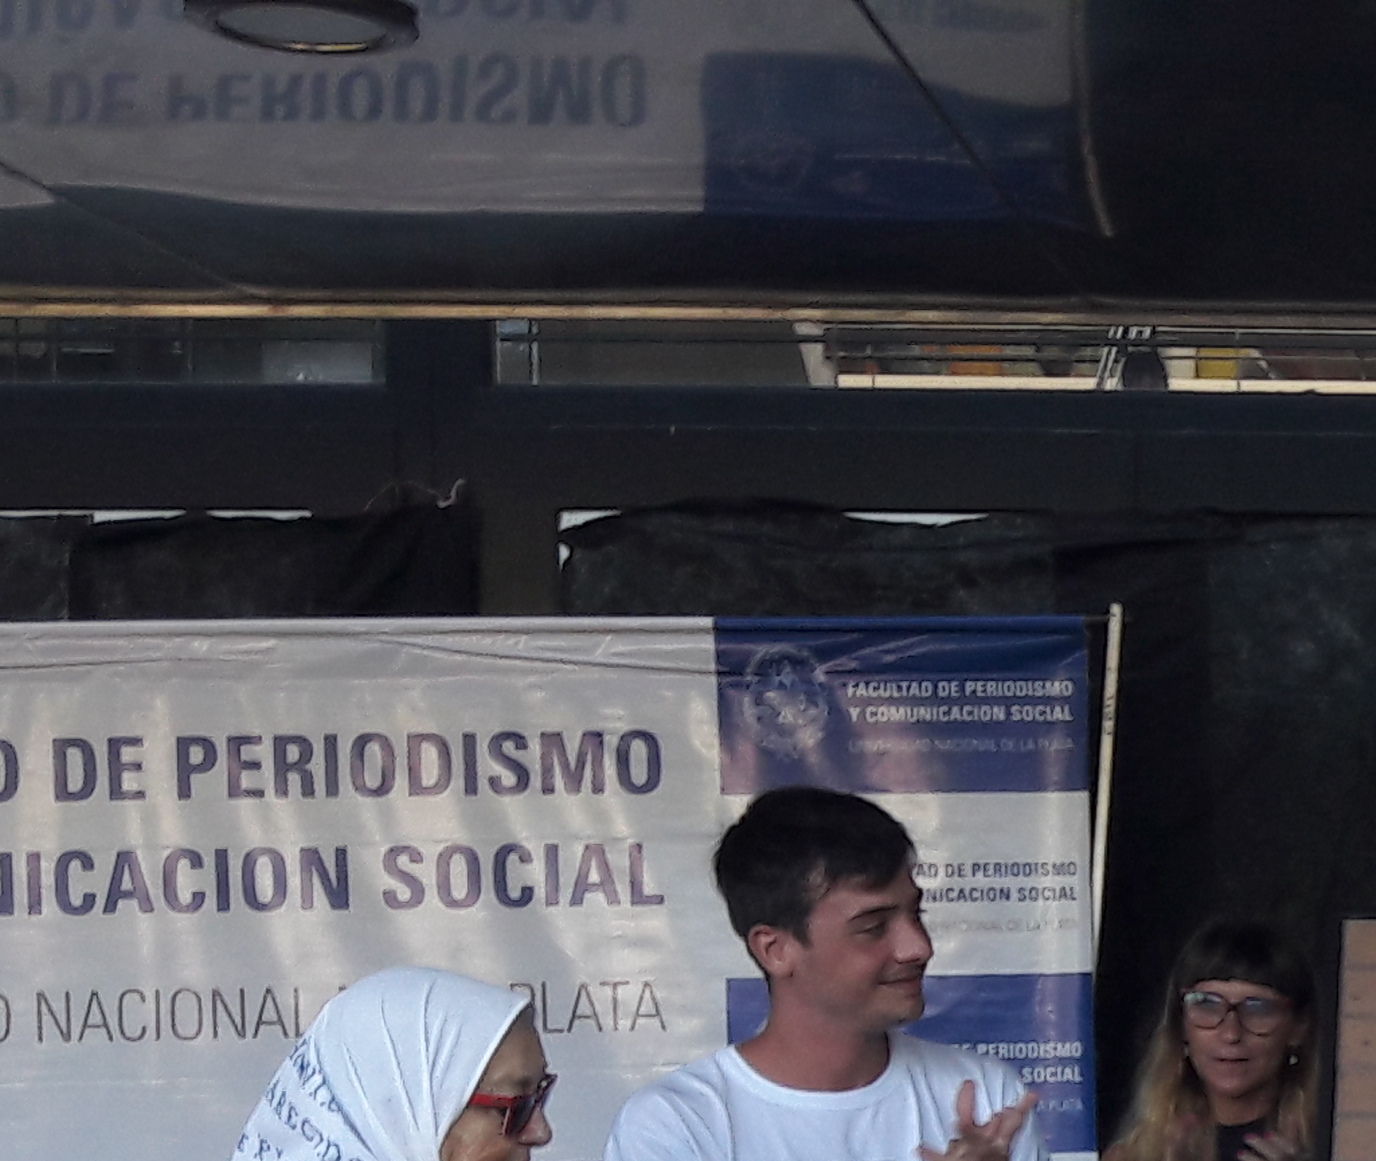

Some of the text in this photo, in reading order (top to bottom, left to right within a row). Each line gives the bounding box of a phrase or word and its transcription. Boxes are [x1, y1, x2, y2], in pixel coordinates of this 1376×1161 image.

[847, 679, 1074, 698] FACULTAD DE PERIODISMO
[848, 704, 1074, 723] Y COMUNICACION SOCIAL
[53, 737, 146, 803] DE
[176, 730, 661, 801] PERIODISMO
[945, 863, 967, 877] DE
[972, 862, 1077, 878] PERIODISMO
[0, 843, 665, 917] ICACION SOCIAL
[922, 886, 1077, 902] NICACION SOCIAL
[1021, 1064, 1084, 1083] SOCIAL
